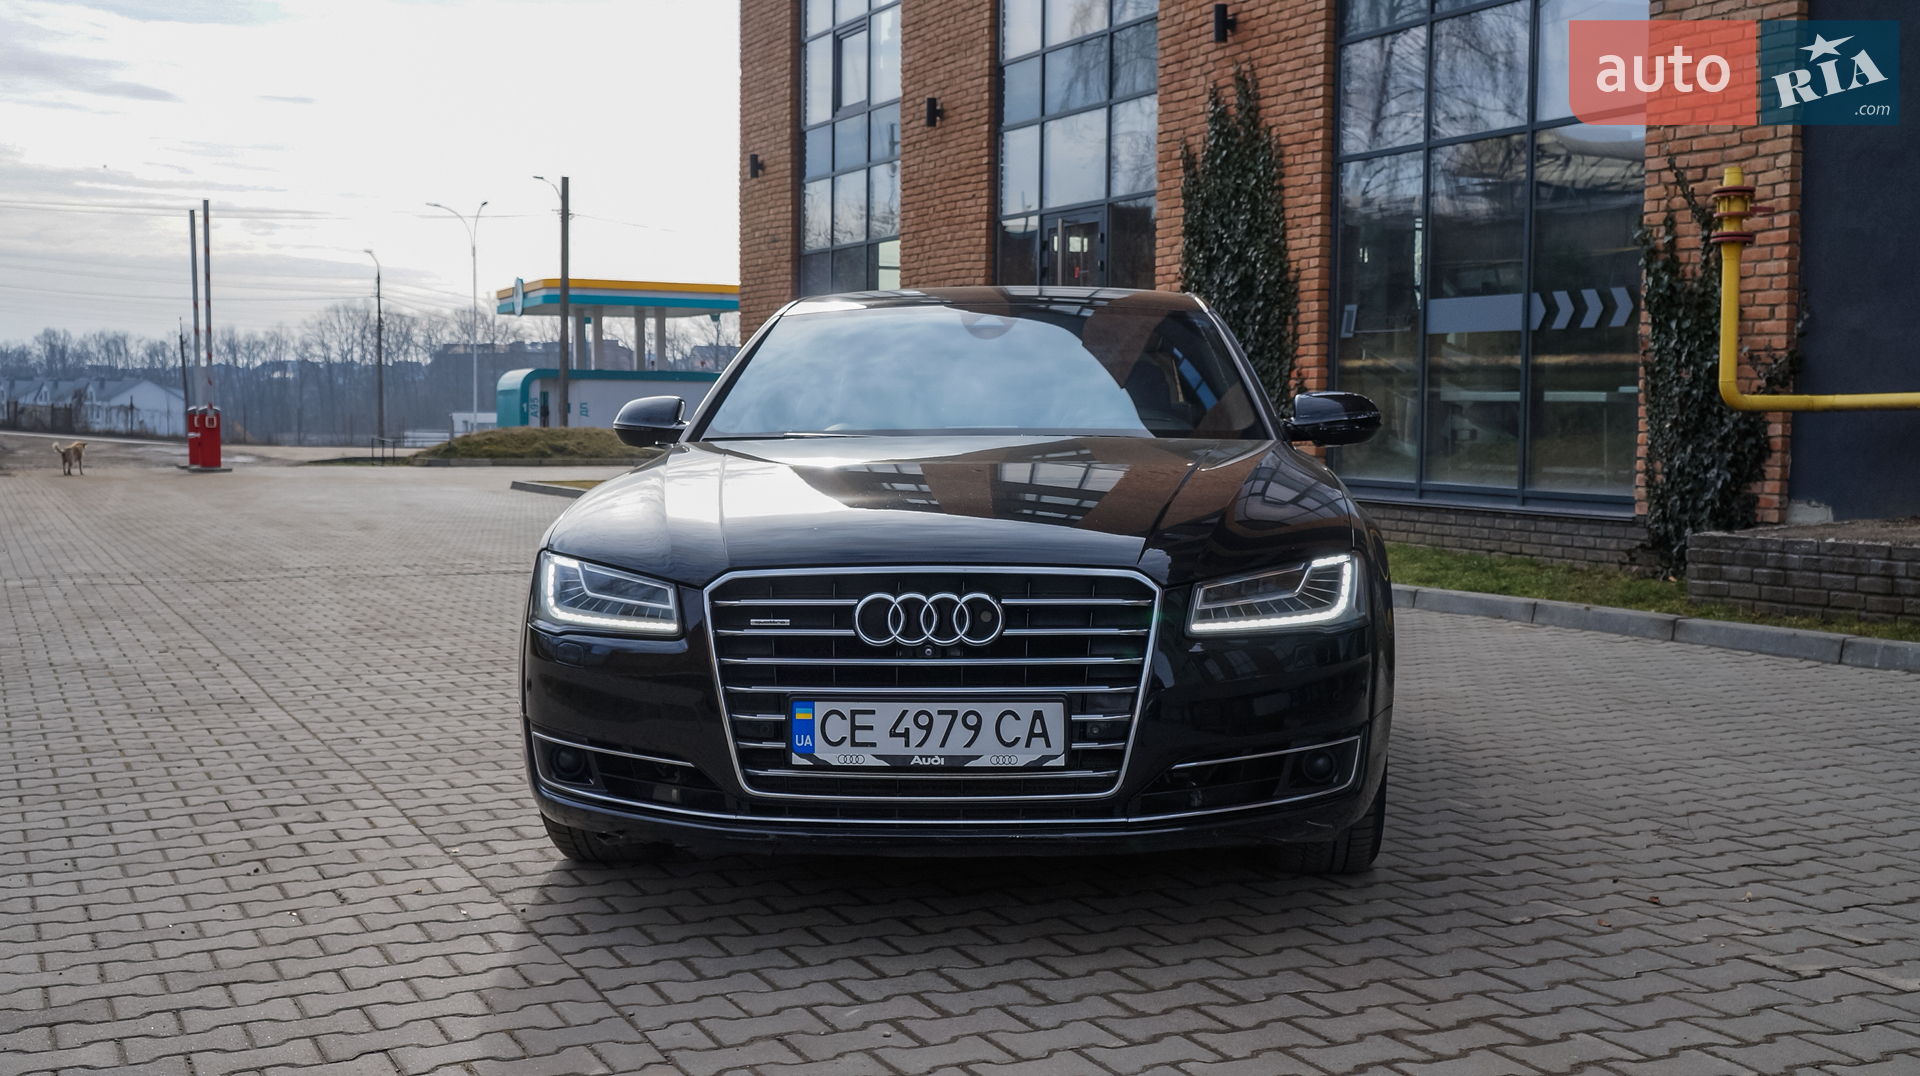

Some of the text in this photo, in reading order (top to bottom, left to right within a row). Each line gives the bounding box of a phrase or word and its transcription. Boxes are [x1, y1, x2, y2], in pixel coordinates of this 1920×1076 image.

[820, 709, 1052, 748] CE 4979 CA
[795, 734, 813, 746] UA
[910, 755, 945, 766] Audi
